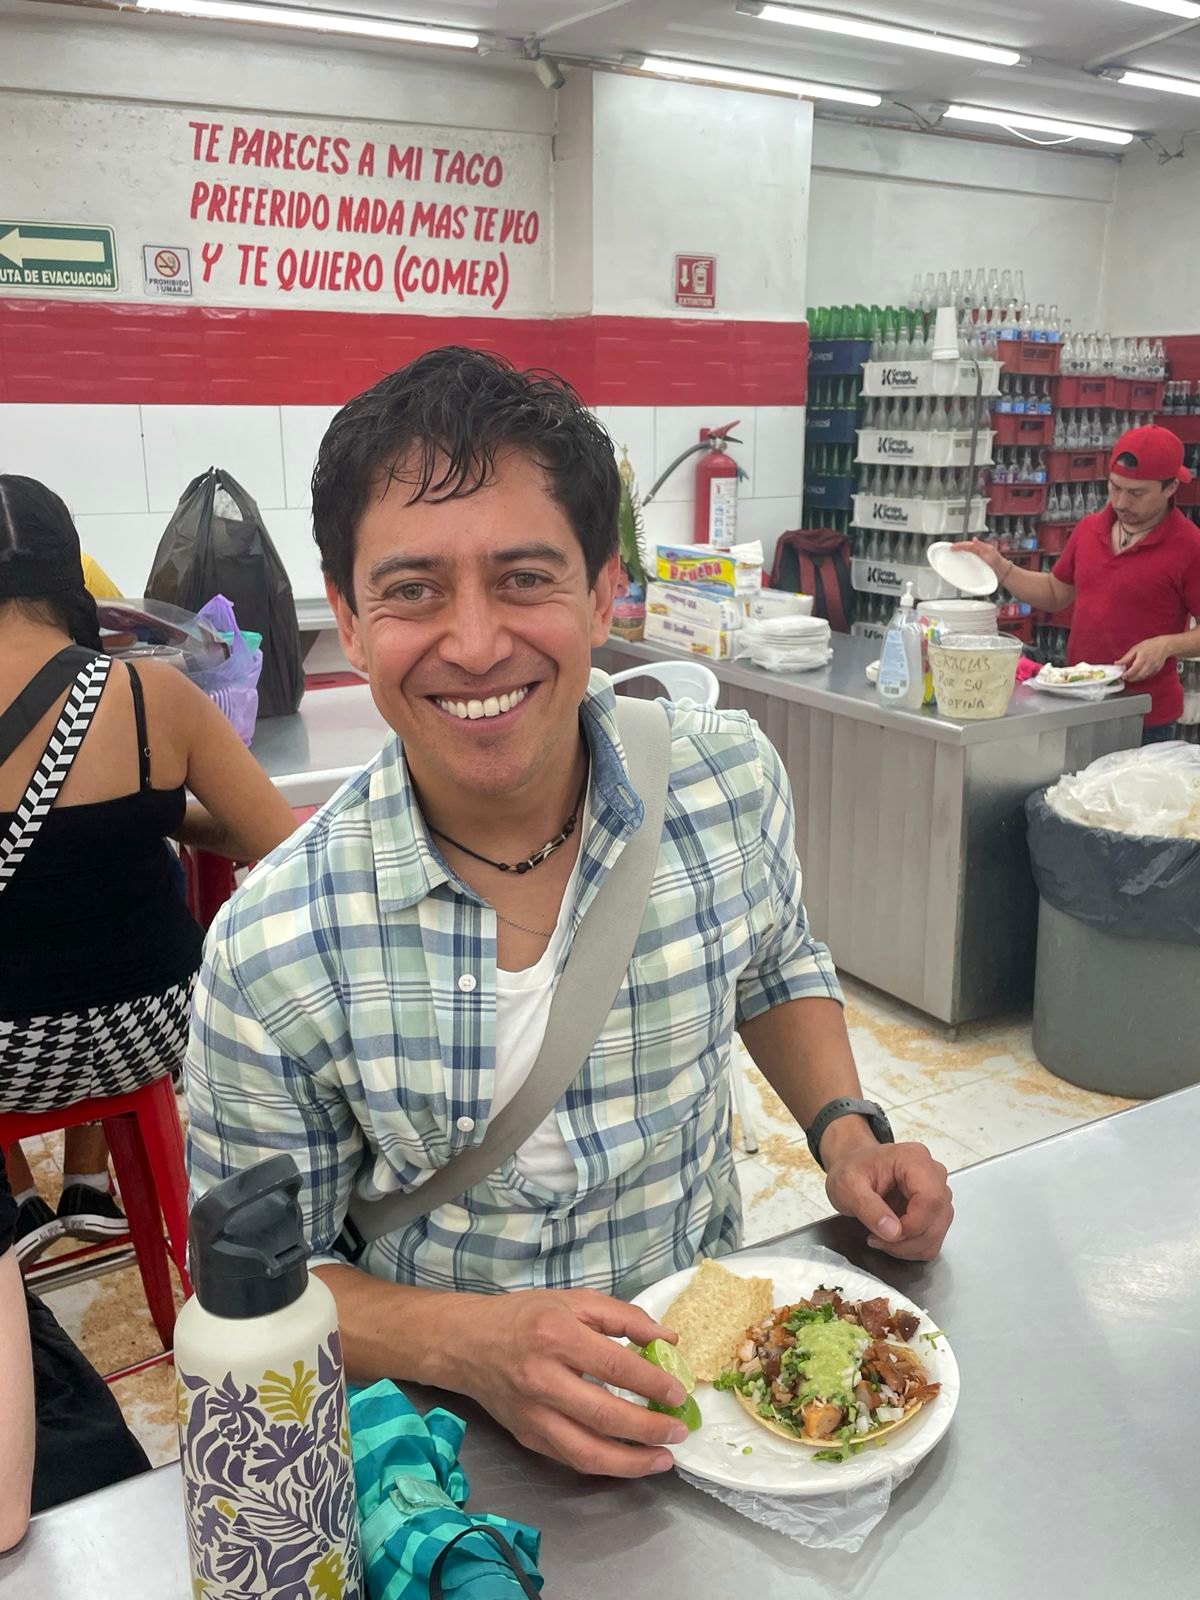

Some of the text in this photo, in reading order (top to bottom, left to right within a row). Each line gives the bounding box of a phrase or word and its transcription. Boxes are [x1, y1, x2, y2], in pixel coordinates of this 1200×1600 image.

[189, 121, 503, 188] TE PARECES A MI TACO
[190, 180, 539, 244] PREFERIDO NADA MAS TE VEO
[0, 268, 112, 287] UTA DE EVACUACION
[149, 278, 189, 288] PROHIBIDO
[201, 242, 509, 311] Y TE QUIERO (COMER)
[964, 678, 983, 692] SU
